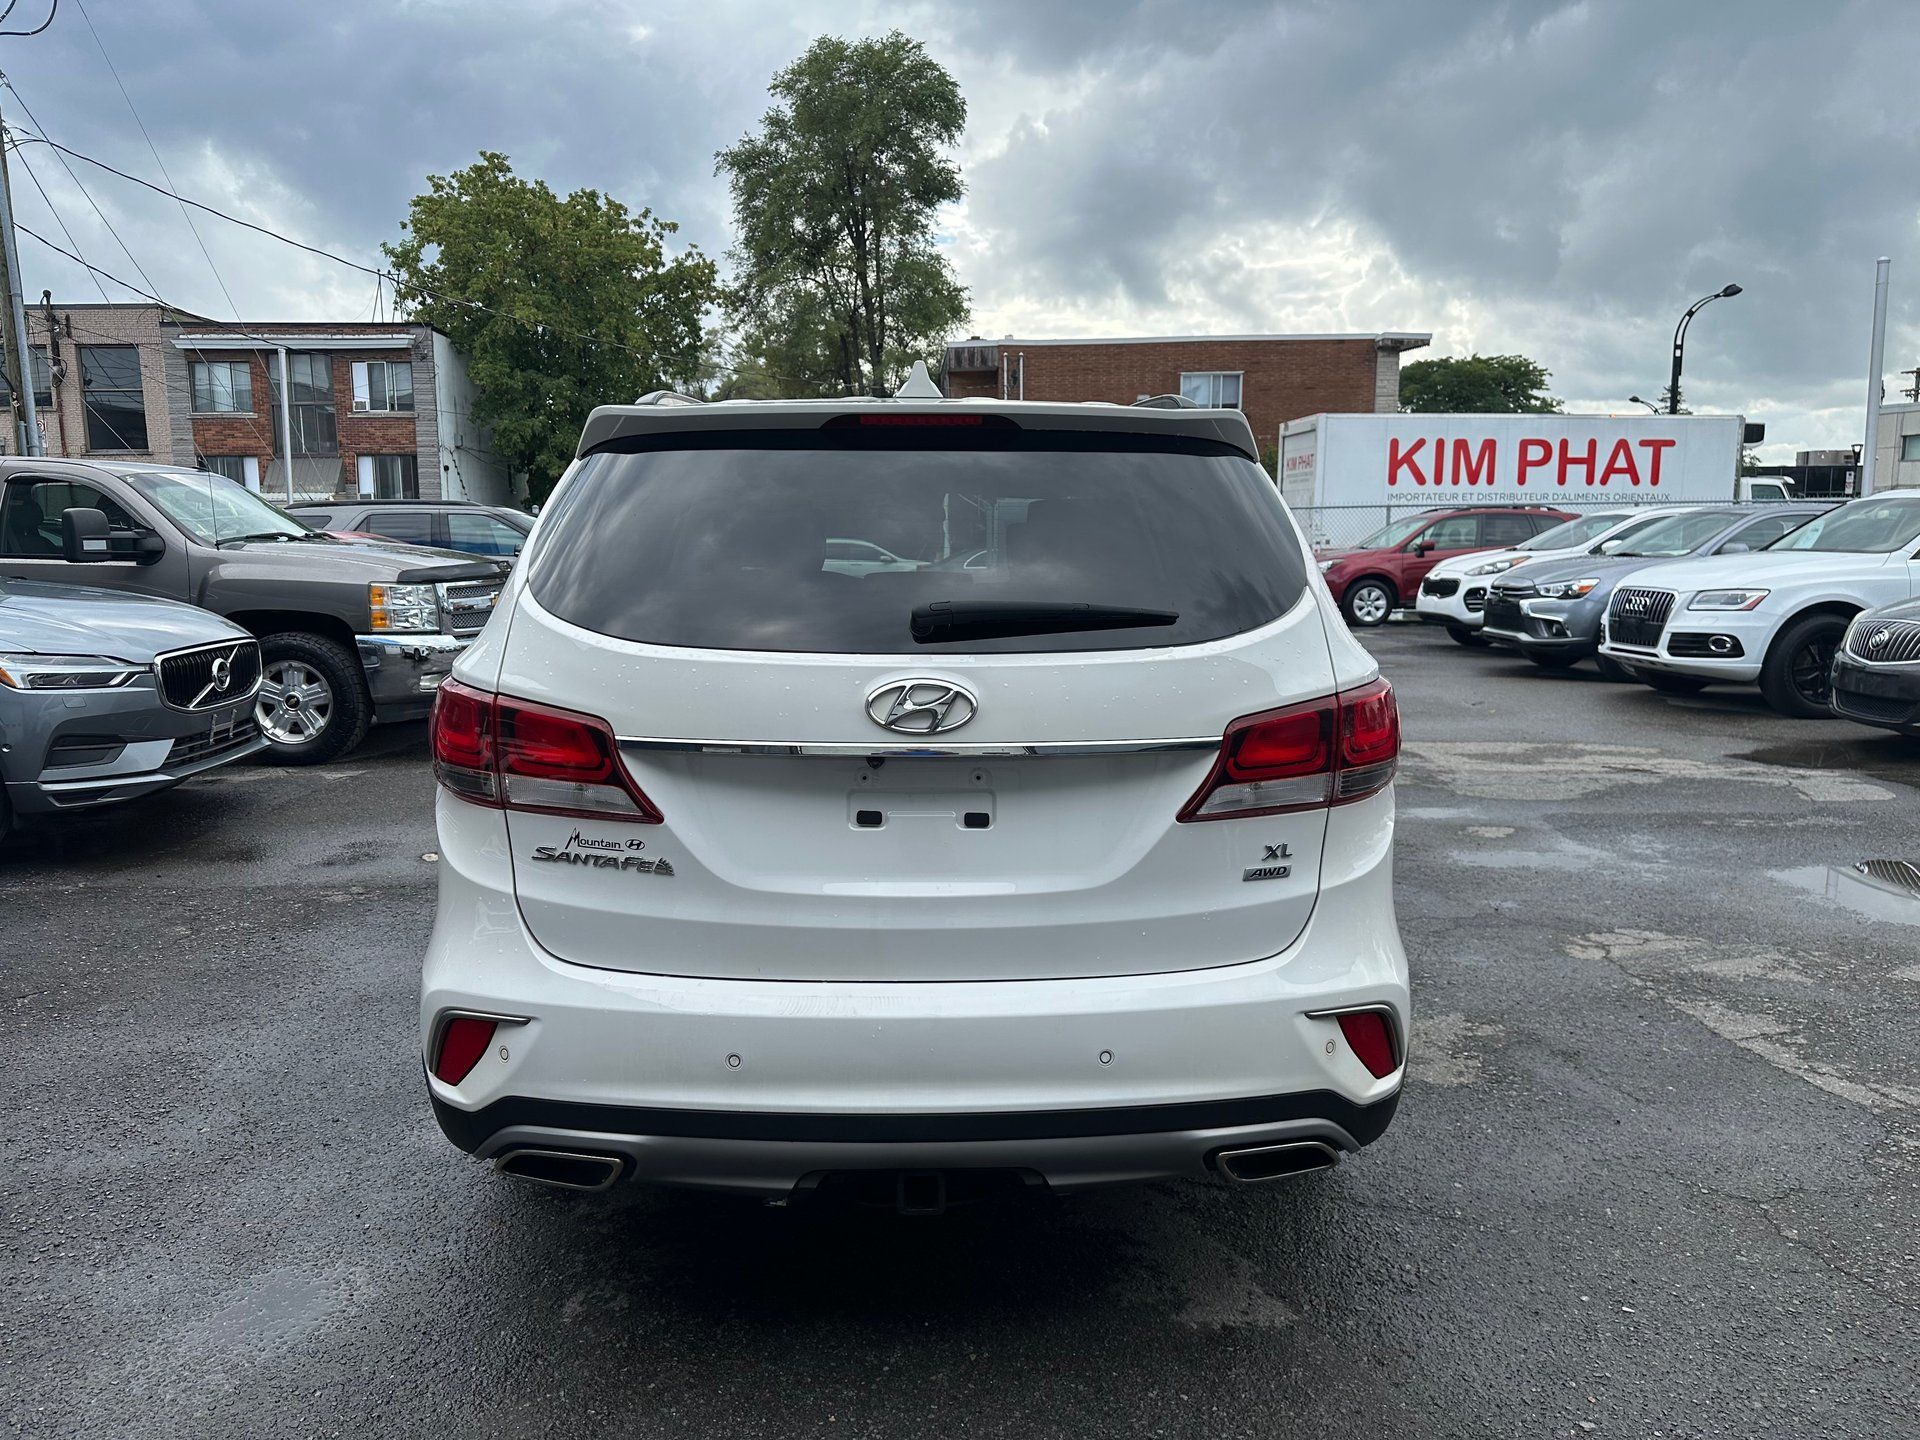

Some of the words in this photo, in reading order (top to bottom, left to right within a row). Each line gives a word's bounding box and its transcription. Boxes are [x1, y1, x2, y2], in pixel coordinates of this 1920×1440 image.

[1387, 437, 1497, 486] KIM
[1517, 437, 1676, 486] PHAT
[1387, 492, 1459, 501] IMPORTATEUR
[1461, 492, 1474, 501] ET
[1477, 492, 1550, 501] DISTRIBUTEUR
[1552, 492, 1610, 501] D'ALIMENTS
[1613, 492, 1671, 501] ORIENTAUX
[565, 828, 622, 850] Mountain
[1261, 842, 1293, 861] XL
[1250, 866, 1288, 878] AWD
